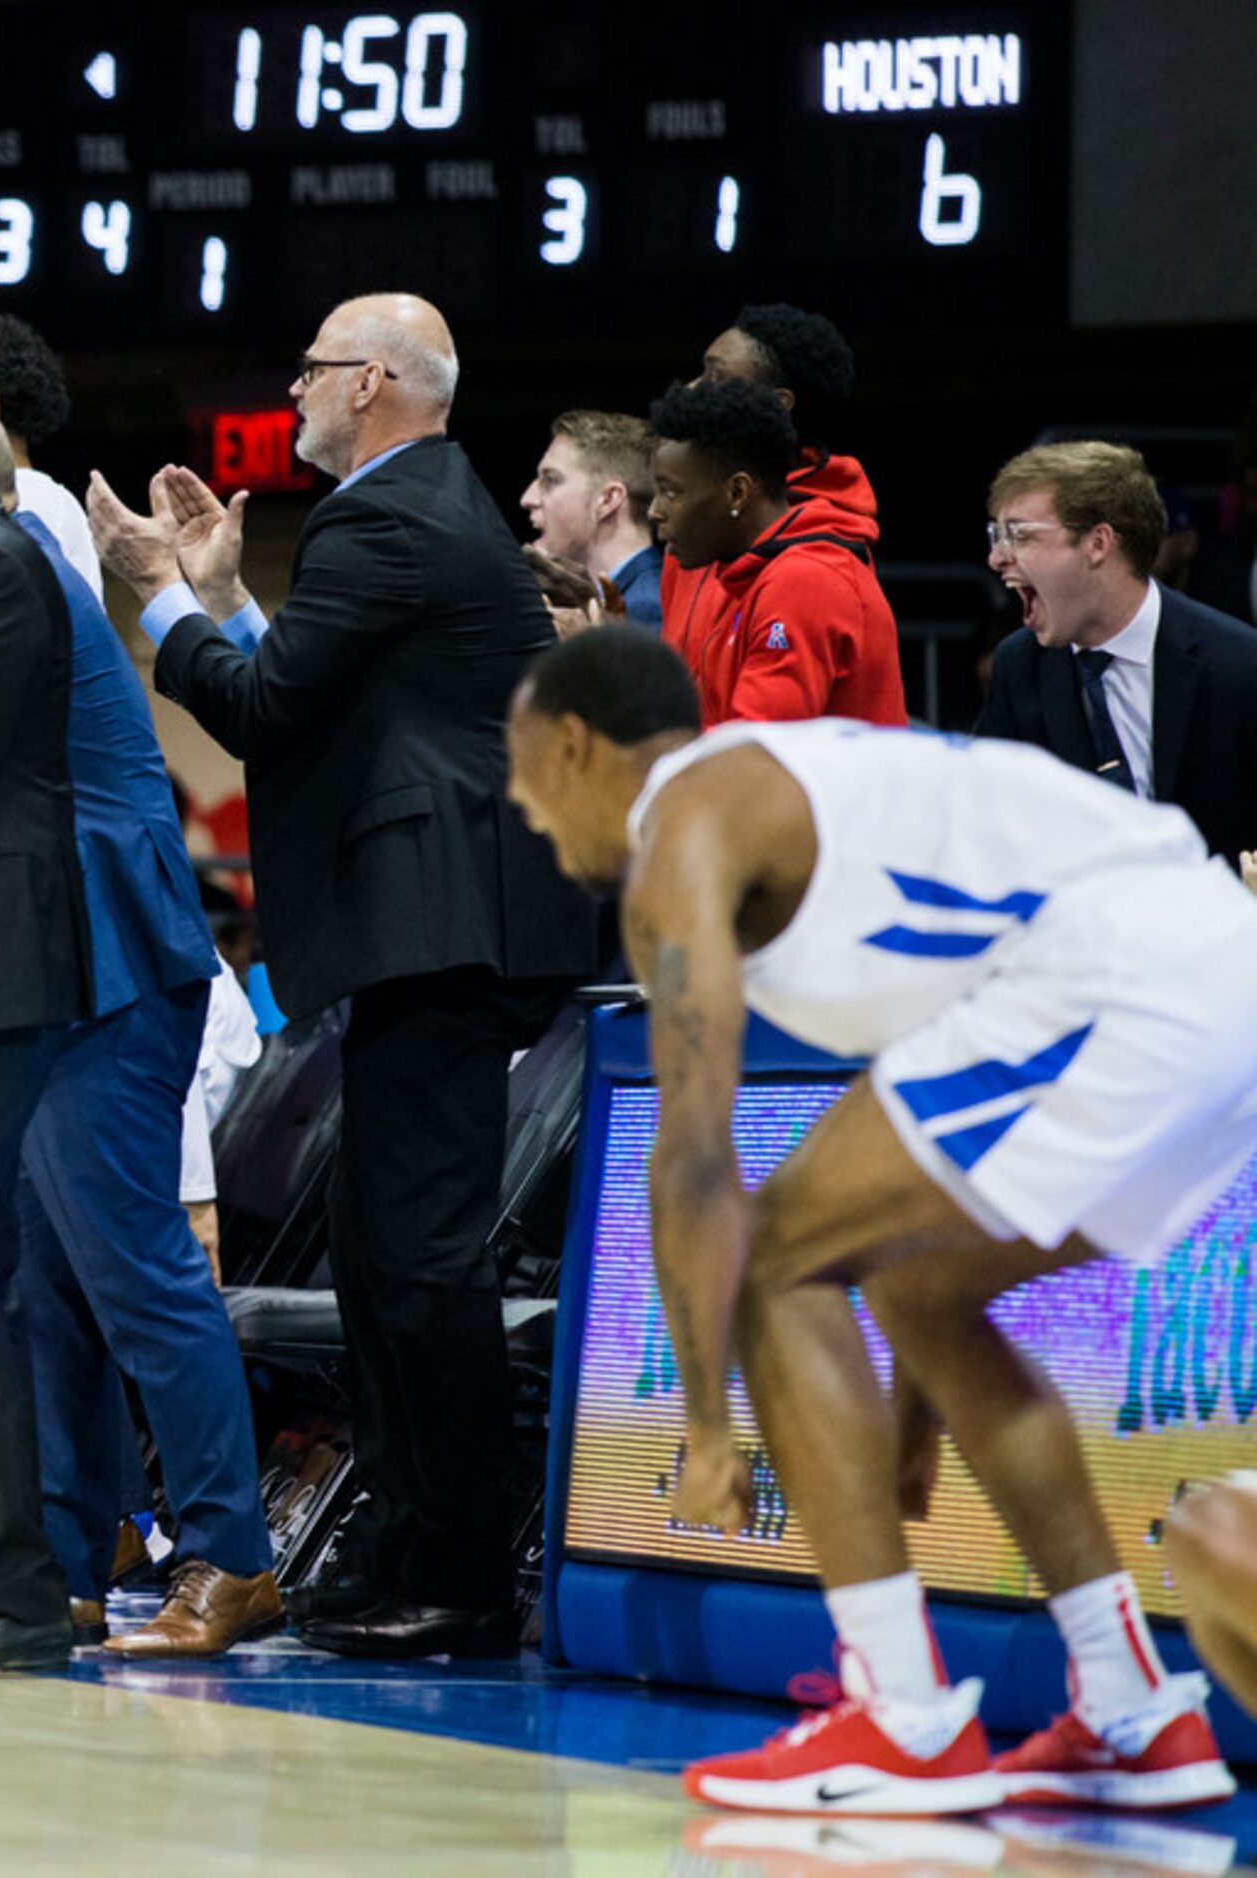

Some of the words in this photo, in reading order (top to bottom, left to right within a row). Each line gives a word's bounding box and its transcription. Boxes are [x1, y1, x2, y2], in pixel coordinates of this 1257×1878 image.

[233, 12, 467, 133] 11:50
[822, 34, 1020, 114] HOUSTON
[540, 177, 587, 264] 3
[715, 176, 739, 252] 1
[919, 133, 981, 245] 6
[81, 201, 131, 275] 4
[199, 237, 227, 311] 1
